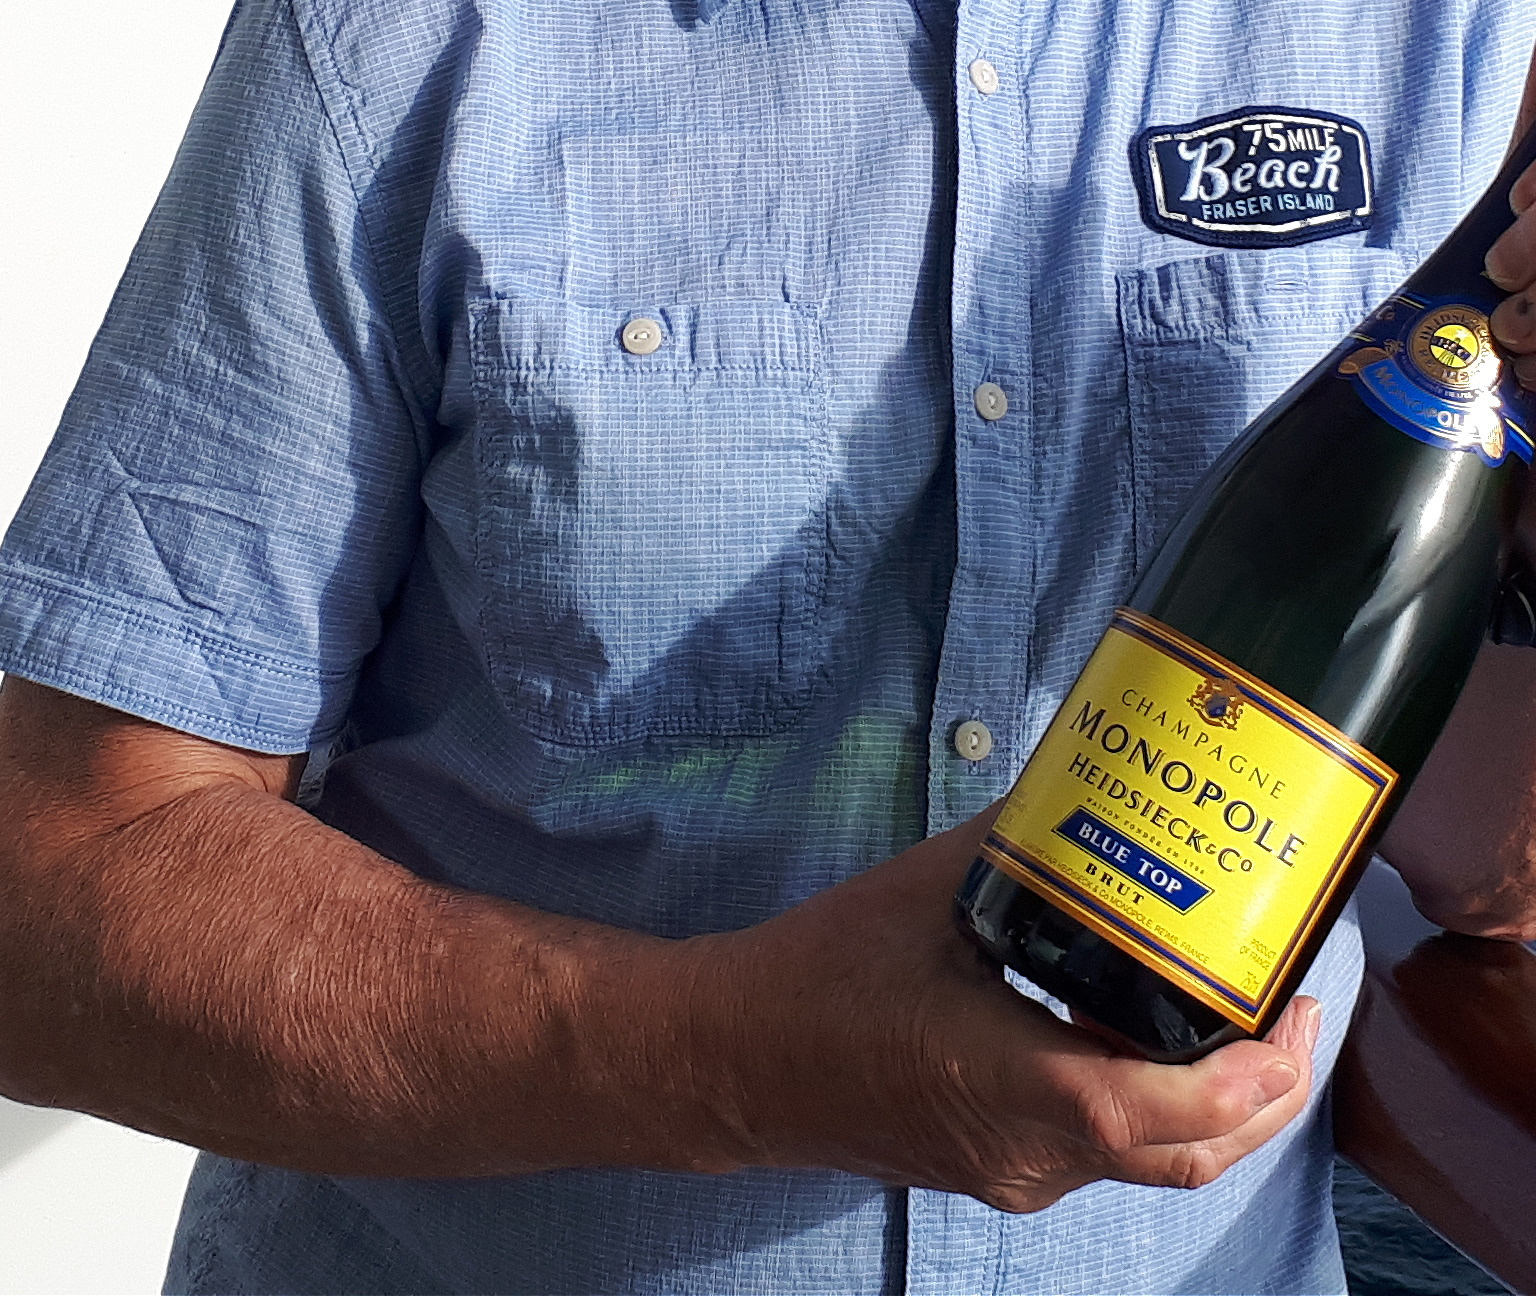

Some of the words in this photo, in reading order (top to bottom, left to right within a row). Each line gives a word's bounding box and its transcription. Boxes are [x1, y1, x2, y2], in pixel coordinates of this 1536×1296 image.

[1177, 137, 1343, 201] Beach
[1202, 195, 1273, 221] FRASER
[1278, 193, 1335, 212] ISLAND
[1121, 688, 1287, 800] CHAMPAGNE
[1069, 700, 1308, 868] MONOPOLE
[1078, 821, 1132, 864] BLUE
[1138, 857, 1184, 895] TOP
[1084, 861, 1145, 906] BRUT
[1180, 941, 1210, 964] FRANCE
